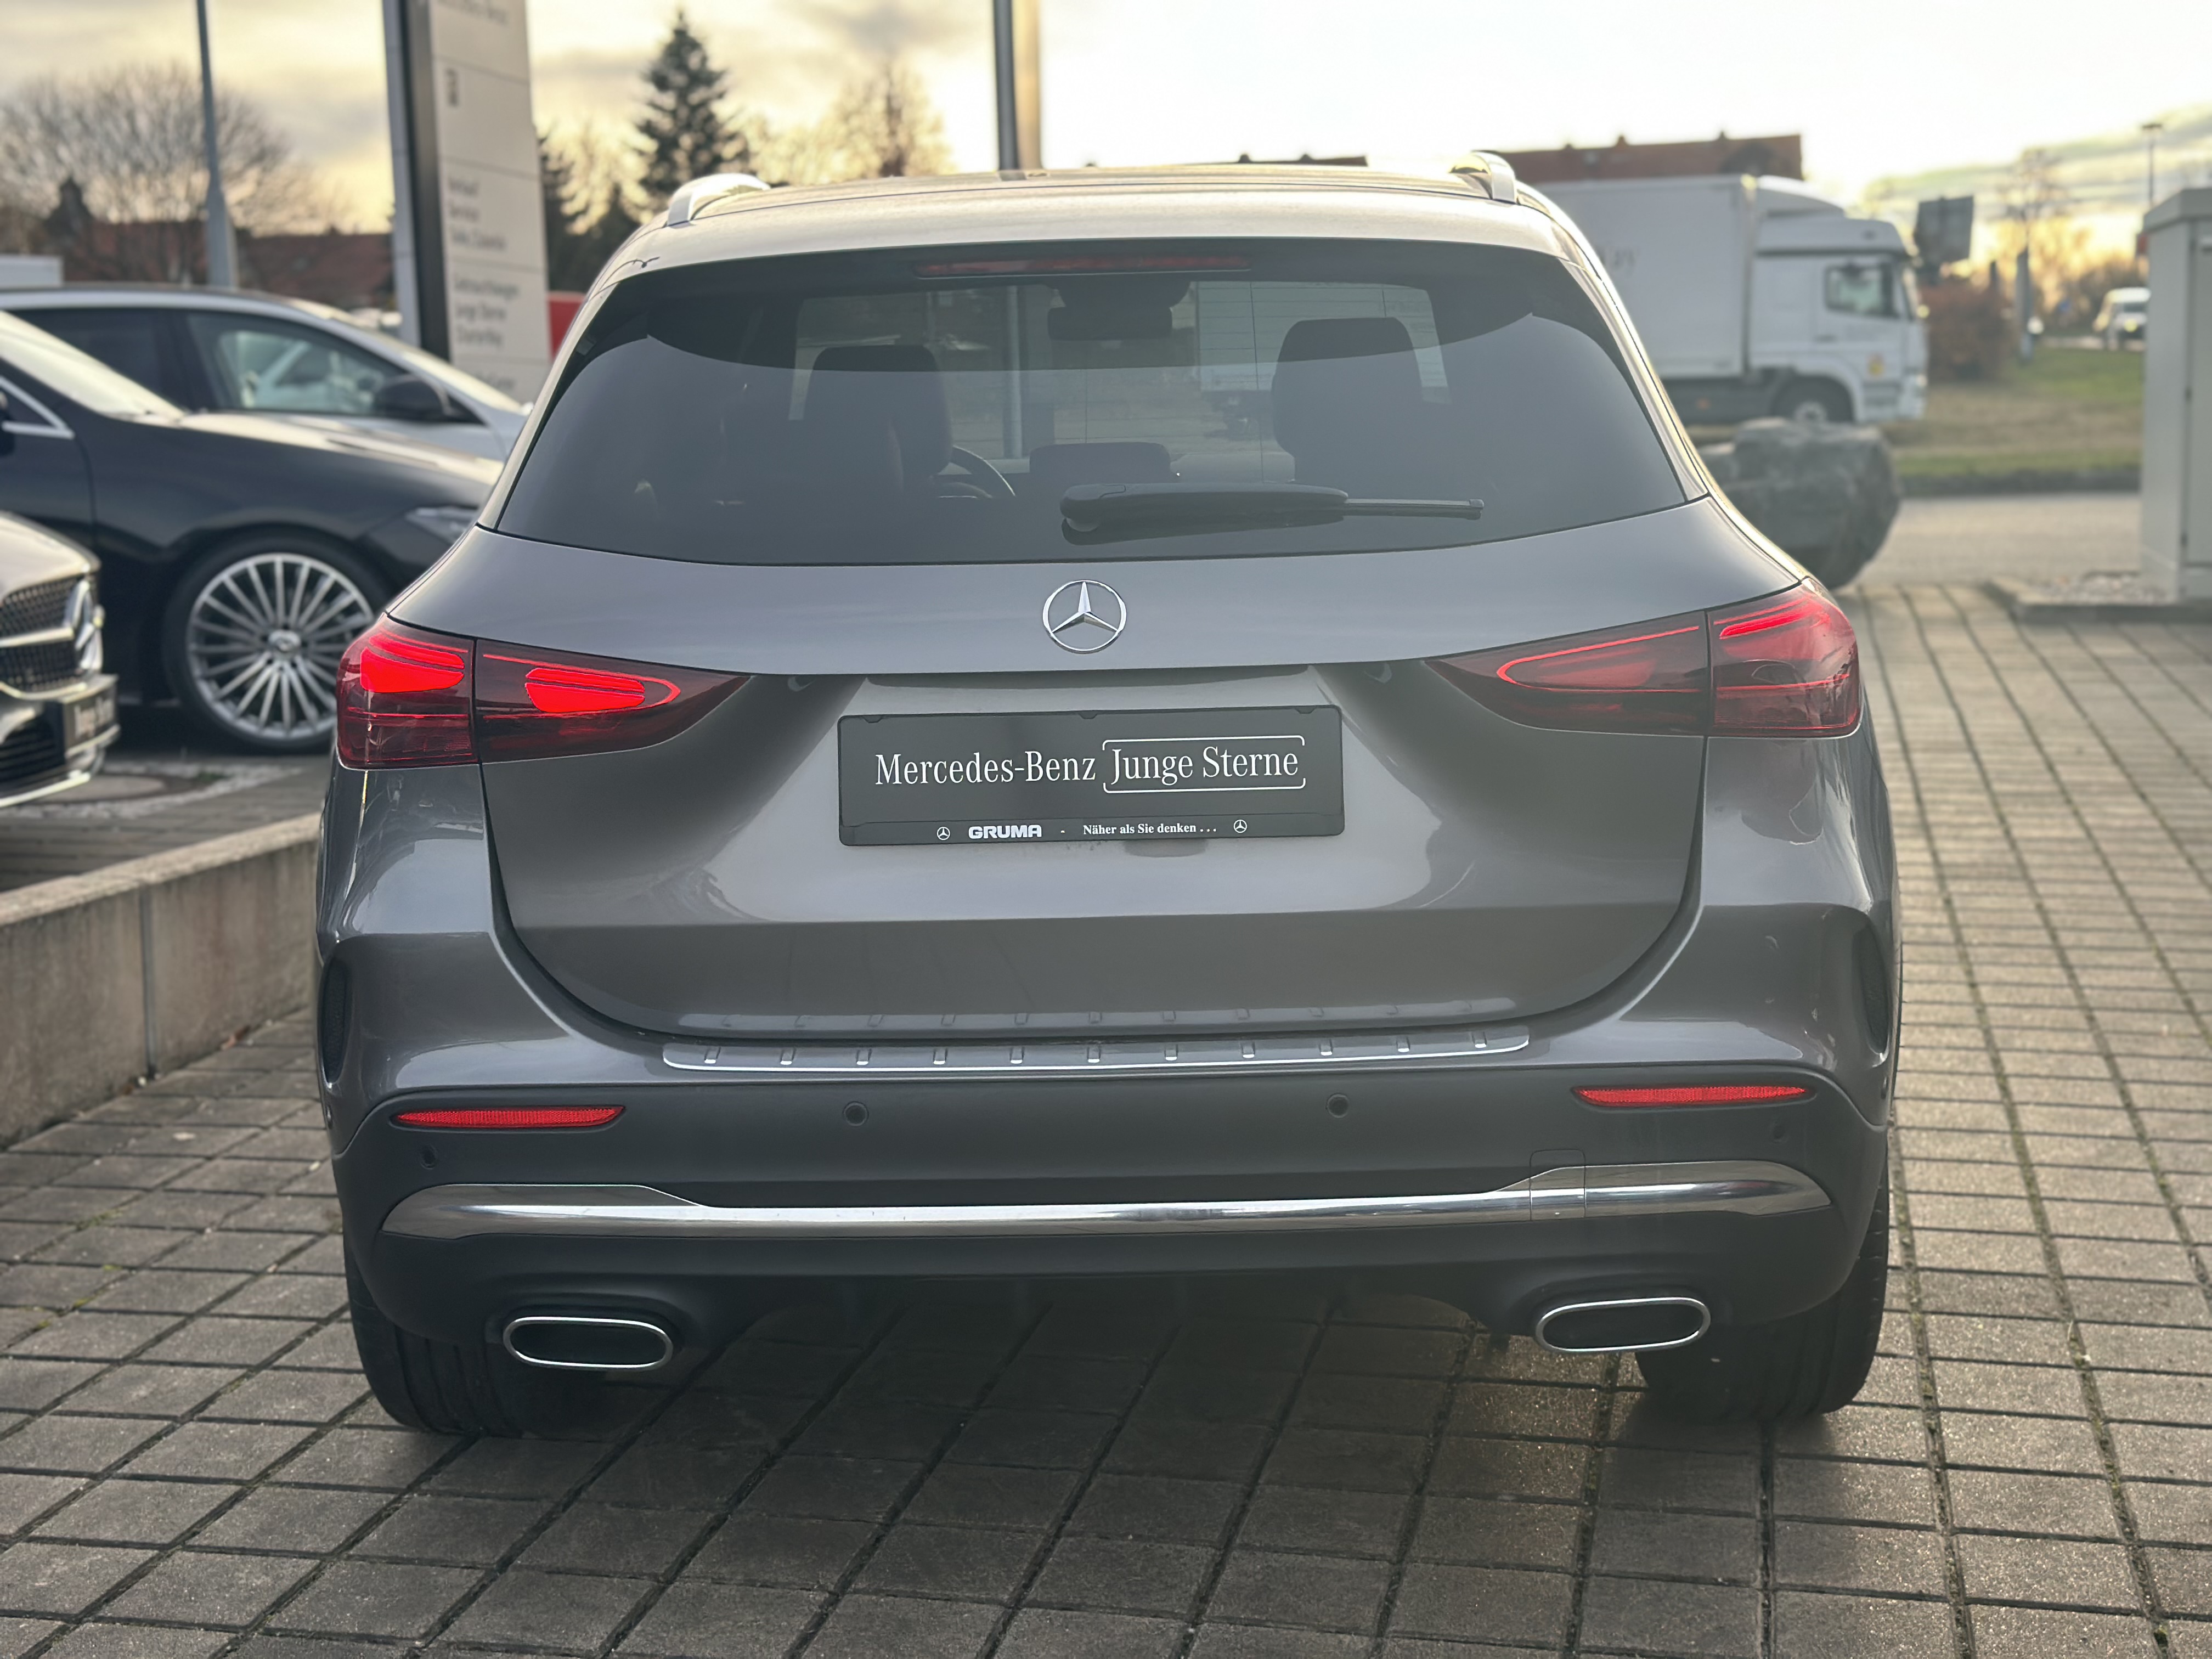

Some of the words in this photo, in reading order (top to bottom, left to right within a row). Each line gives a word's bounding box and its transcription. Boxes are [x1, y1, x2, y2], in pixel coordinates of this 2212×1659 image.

[875, 751, 1096, 785] Mercedes-Benz
[1110, 749, 1193, 786] Junge
[1202, 746, 1299, 777] Sterne
[968, 825, 1042, 839] GRUMA
[1083, 824, 1117, 835] Näher
[1120, 824, 1136, 834] als
[1138, 823, 1154, 833] Sie
[1157, 823, 1197, 833] denken
